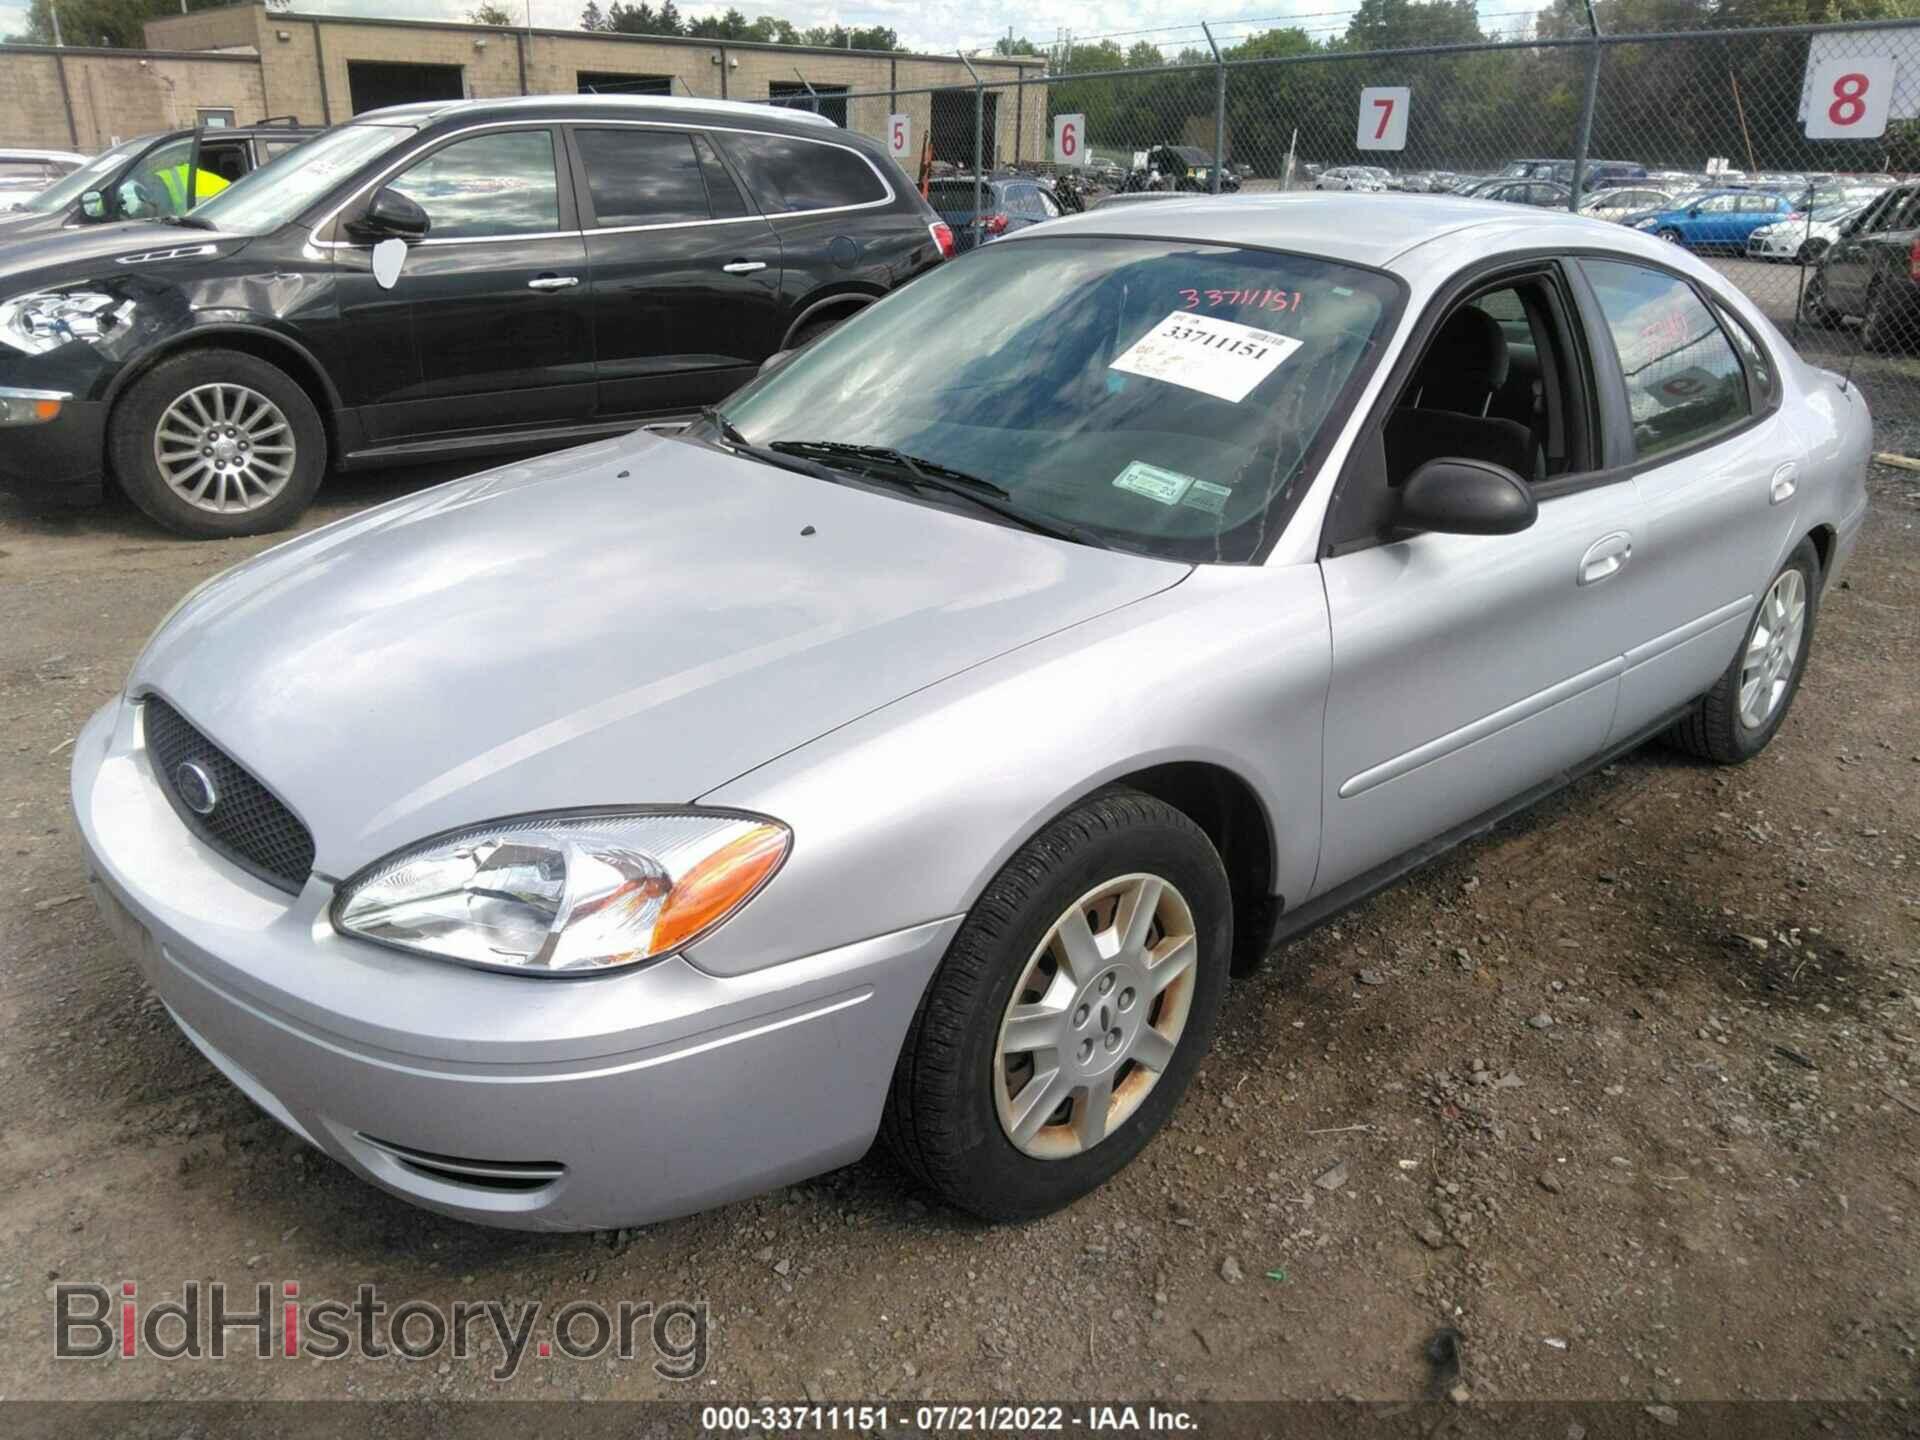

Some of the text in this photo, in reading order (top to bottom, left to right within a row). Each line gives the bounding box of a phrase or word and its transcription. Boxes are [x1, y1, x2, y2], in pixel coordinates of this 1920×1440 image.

[1828, 73, 1870, 126] 8
[894, 122, 904, 150] 5
[1374, 100, 1394, 139] 7
[1061, 123, 1077, 156] 6
[1162, 326, 1268, 360] 33711151
